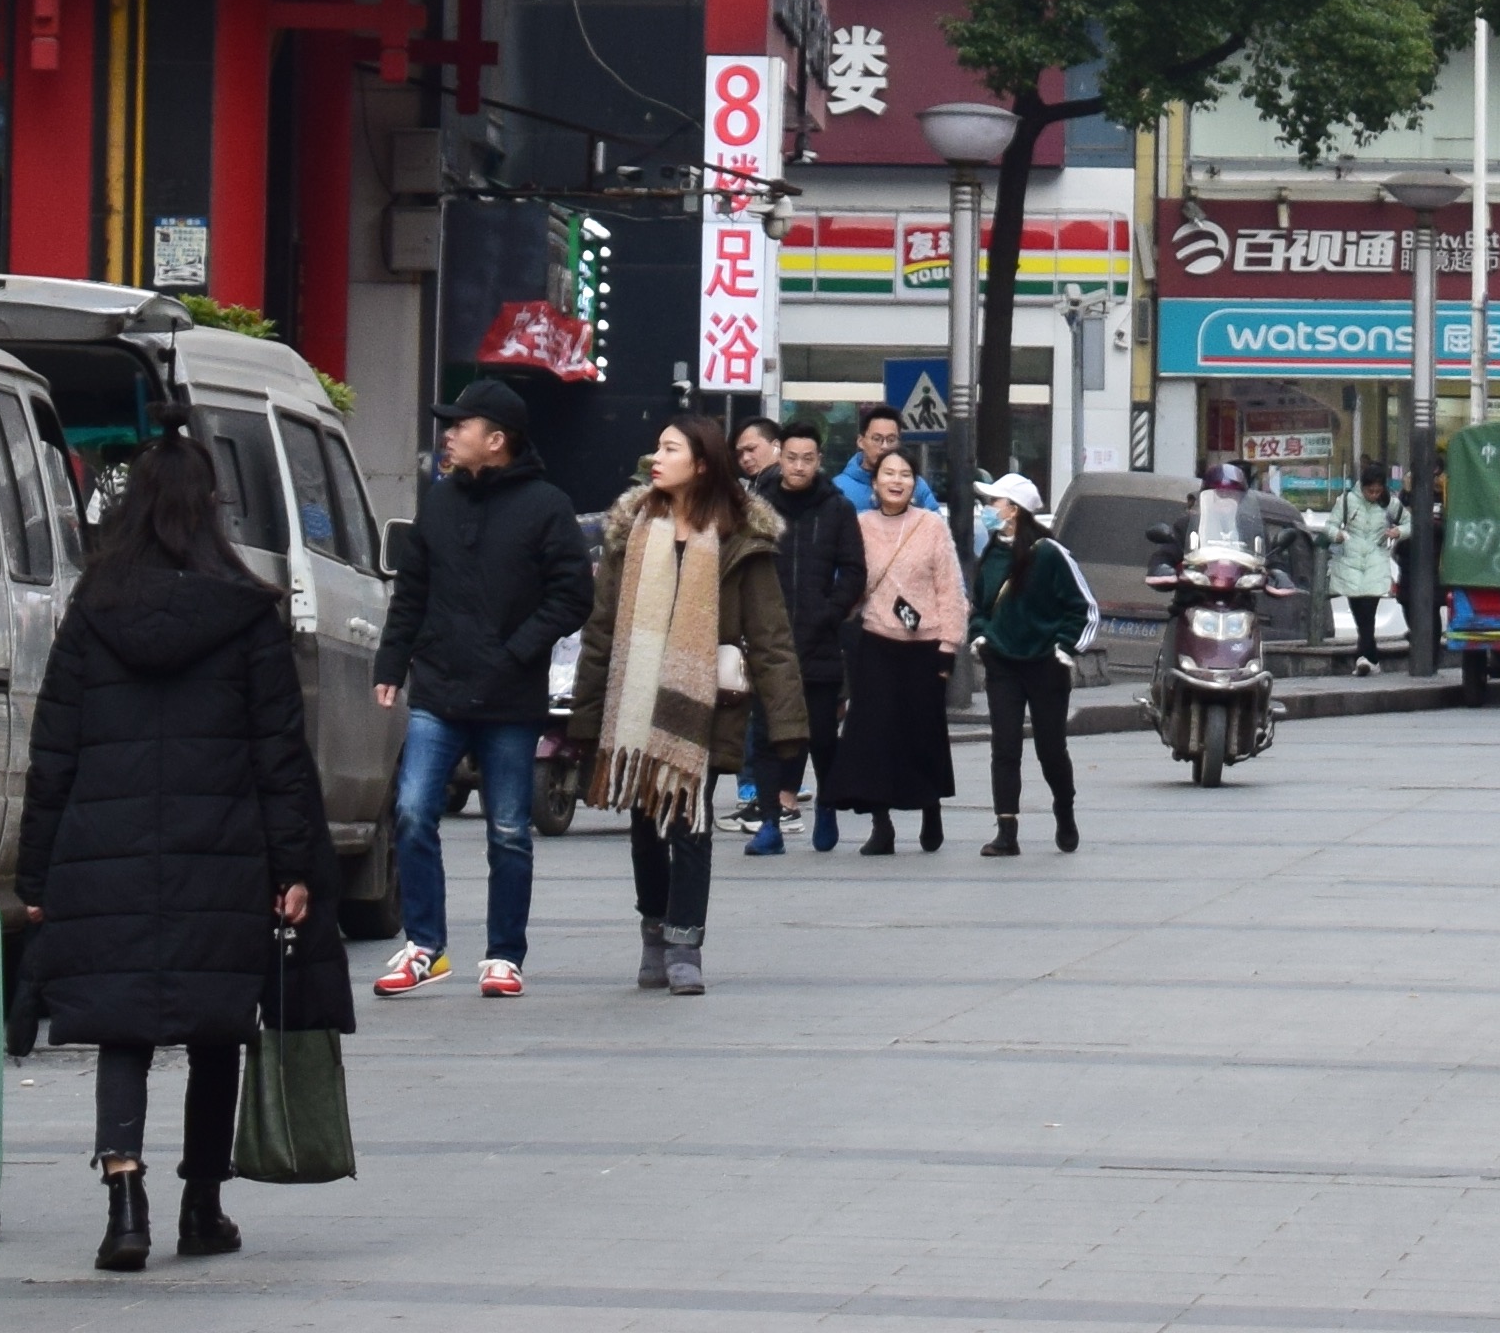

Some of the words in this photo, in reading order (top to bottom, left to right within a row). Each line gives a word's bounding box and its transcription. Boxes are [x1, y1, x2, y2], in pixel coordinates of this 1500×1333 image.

[1233, 229, 1397, 273] 百视通
[1226, 321, 1414, 353] watsons
[1258, 436, 1304, 458] 纹身
